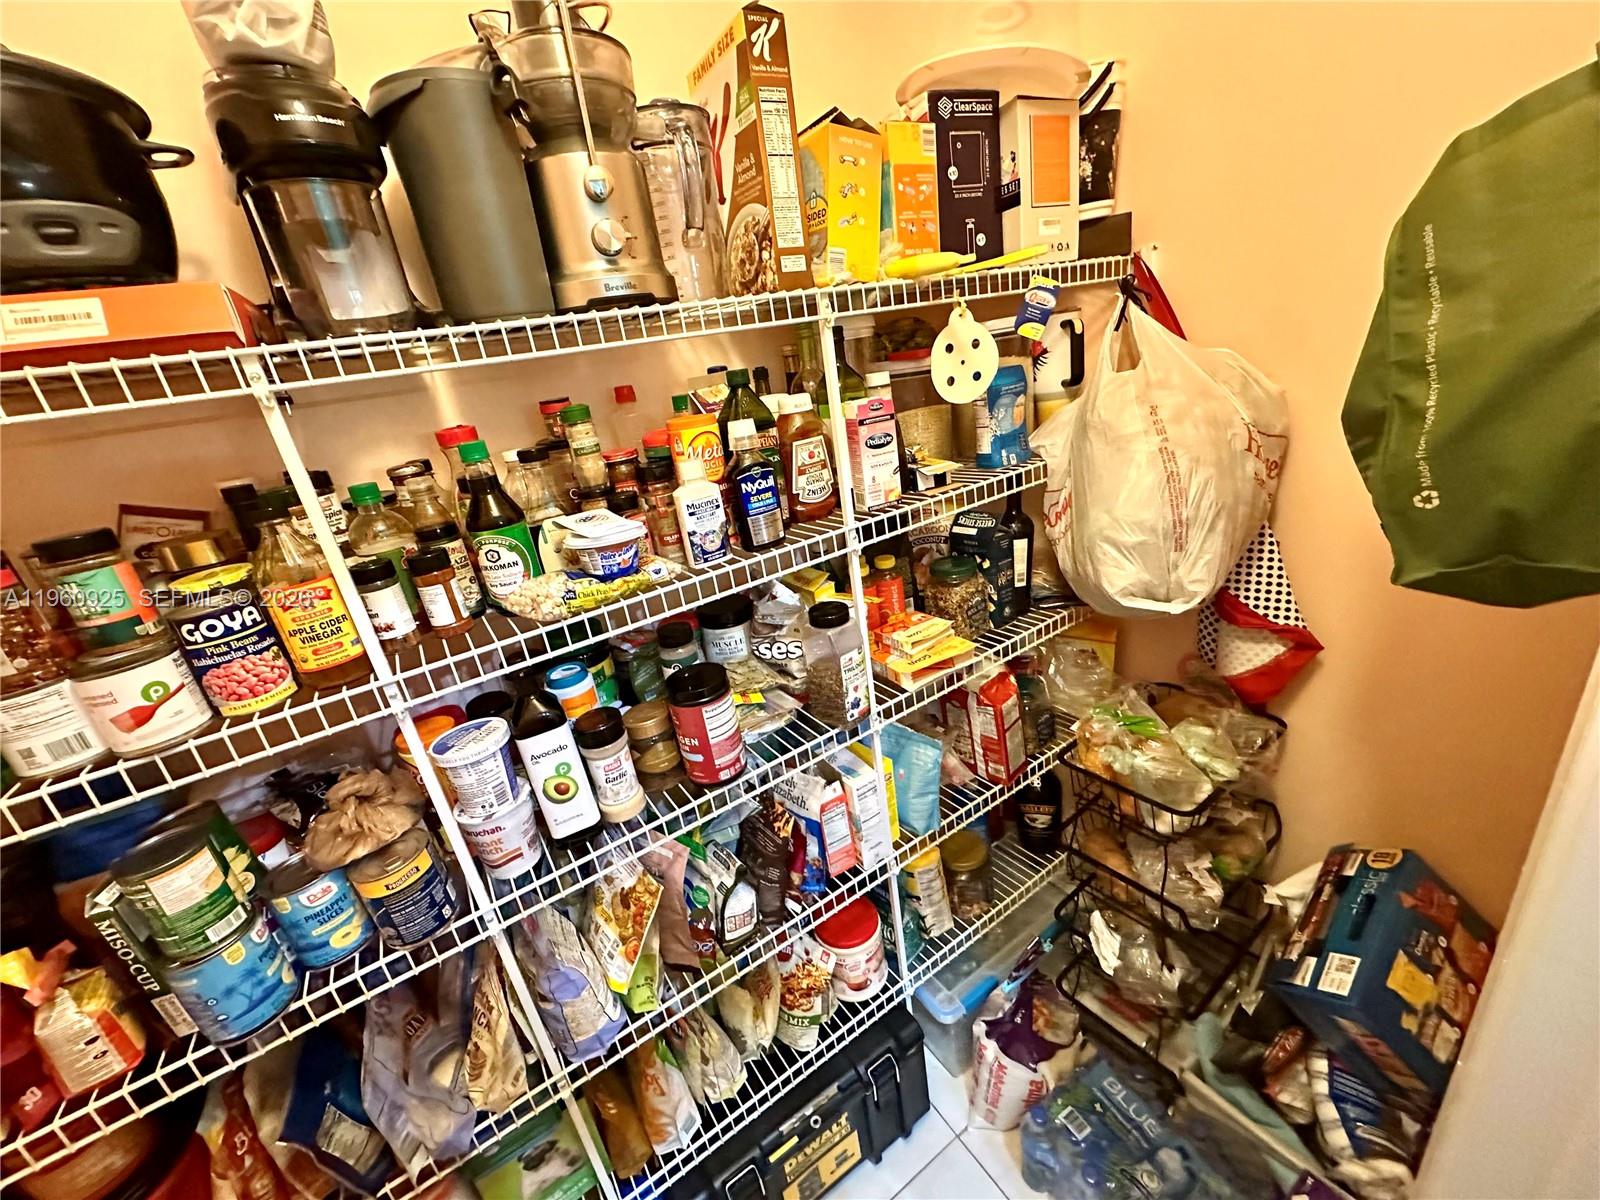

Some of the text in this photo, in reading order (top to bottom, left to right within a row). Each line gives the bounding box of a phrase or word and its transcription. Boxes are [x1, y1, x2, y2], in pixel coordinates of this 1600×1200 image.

[747, 14, 768, 22] SPECIAL
[750, 17, 780, 62] K
[692, 27, 734, 86] FAMILY SIZE
[954, 102, 993, 112] ClearSpace
[273, 113, 345, 127] Hamilton Beach
[735, 157, 751, 172] Vanilla
[737, 167, 757, 184] Almond
[806, 208, 827, 223] SIDED
[1422, 223, 1435, 269] Reusable
[603, 280, 638, 292] Breville
[1427, 275, 1443, 325] Recyclable
[1425, 331, 1437, 363] Plastic
[1426, 364, 1441, 406] Recycled
[759, 435, 777, 448] PEIAN
[867, 435, 893, 447] Pedialyte
[1416, 435, 1427, 458] from
[1417, 461, 1432, 487] Made
[741, 475, 775, 494] NyQuil
[806, 484, 827, 497] HEINZ
[686, 497, 720, 512] Mucinex
[750, 491, 773, 503] SEVERE
[324, 508, 343, 520] spice
[912, 536, 946, 547] COCONUT
[600, 550, 616, 561] Dulce
[577, 589, 595, 599] Chick
[180, 605, 262, 643] GOYA
[287, 624, 317, 638] APPLE
[318, 613, 349, 630] CIDER
[298, 626, 344, 645] VINEGAR
[710, 638, 745, 649] MUSCLE
[205, 634, 260, 656] Pink Beans
[191, 649, 247, 667] Habichuelas
[228, 702, 252, 712] PRIME
[530, 743, 568, 761] Avocado
[605, 770, 628, 785] Garlic
[388, 866, 418, 890] PROGRESSO
[306, 884, 333, 904] Dole
[303, 892, 349, 924] PINEAPPLE
[316, 906, 345, 926] SLICES
[94, 919, 161, 991] MISO-CUP
[788, 1017, 810, 1027] MIX
[1102, 1076, 1161, 1138] BLUE
[783, 1111, 849, 1177] DEWALT
